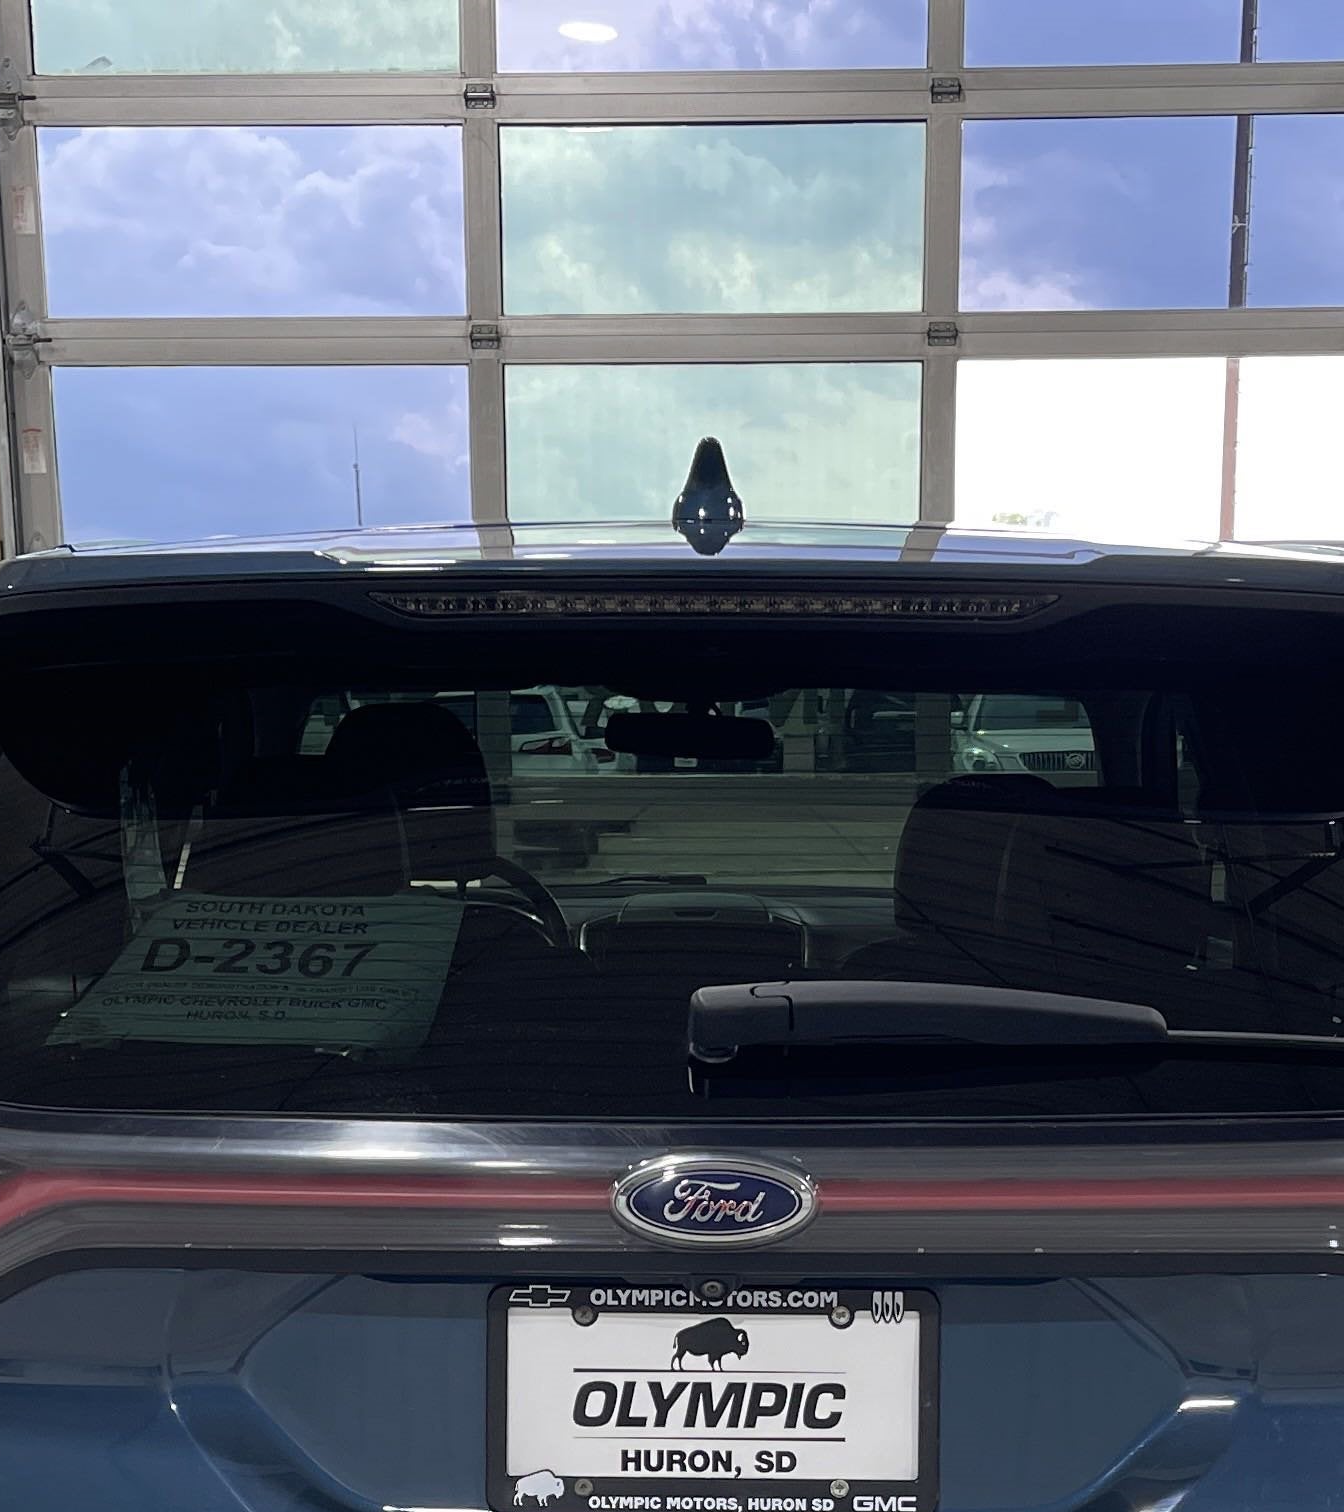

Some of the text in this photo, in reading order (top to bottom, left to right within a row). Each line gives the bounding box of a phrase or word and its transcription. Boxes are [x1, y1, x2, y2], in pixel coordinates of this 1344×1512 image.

[185, 901, 365, 917] SOUTH DAKOTA
[172, 918, 368, 935] VEHICLE DEALER
[140, 938, 378, 979] D-2367
[179, 996, 283, 1008] CHEVROLET
[288, 998, 343, 1010] BUICK
[663, 1179, 766, 1223] Ford
[590, 1288, 838, 1308] OLYMPICMTORS.COM
[573, 1381, 846, 1430] OLYMPIC
[621, 1449, 797, 1478] HURON, SD
[588, 1496, 834, 1512] OLYMPIC MOTORS, HURON SD
[852, 1495, 917, 1512] GMC
